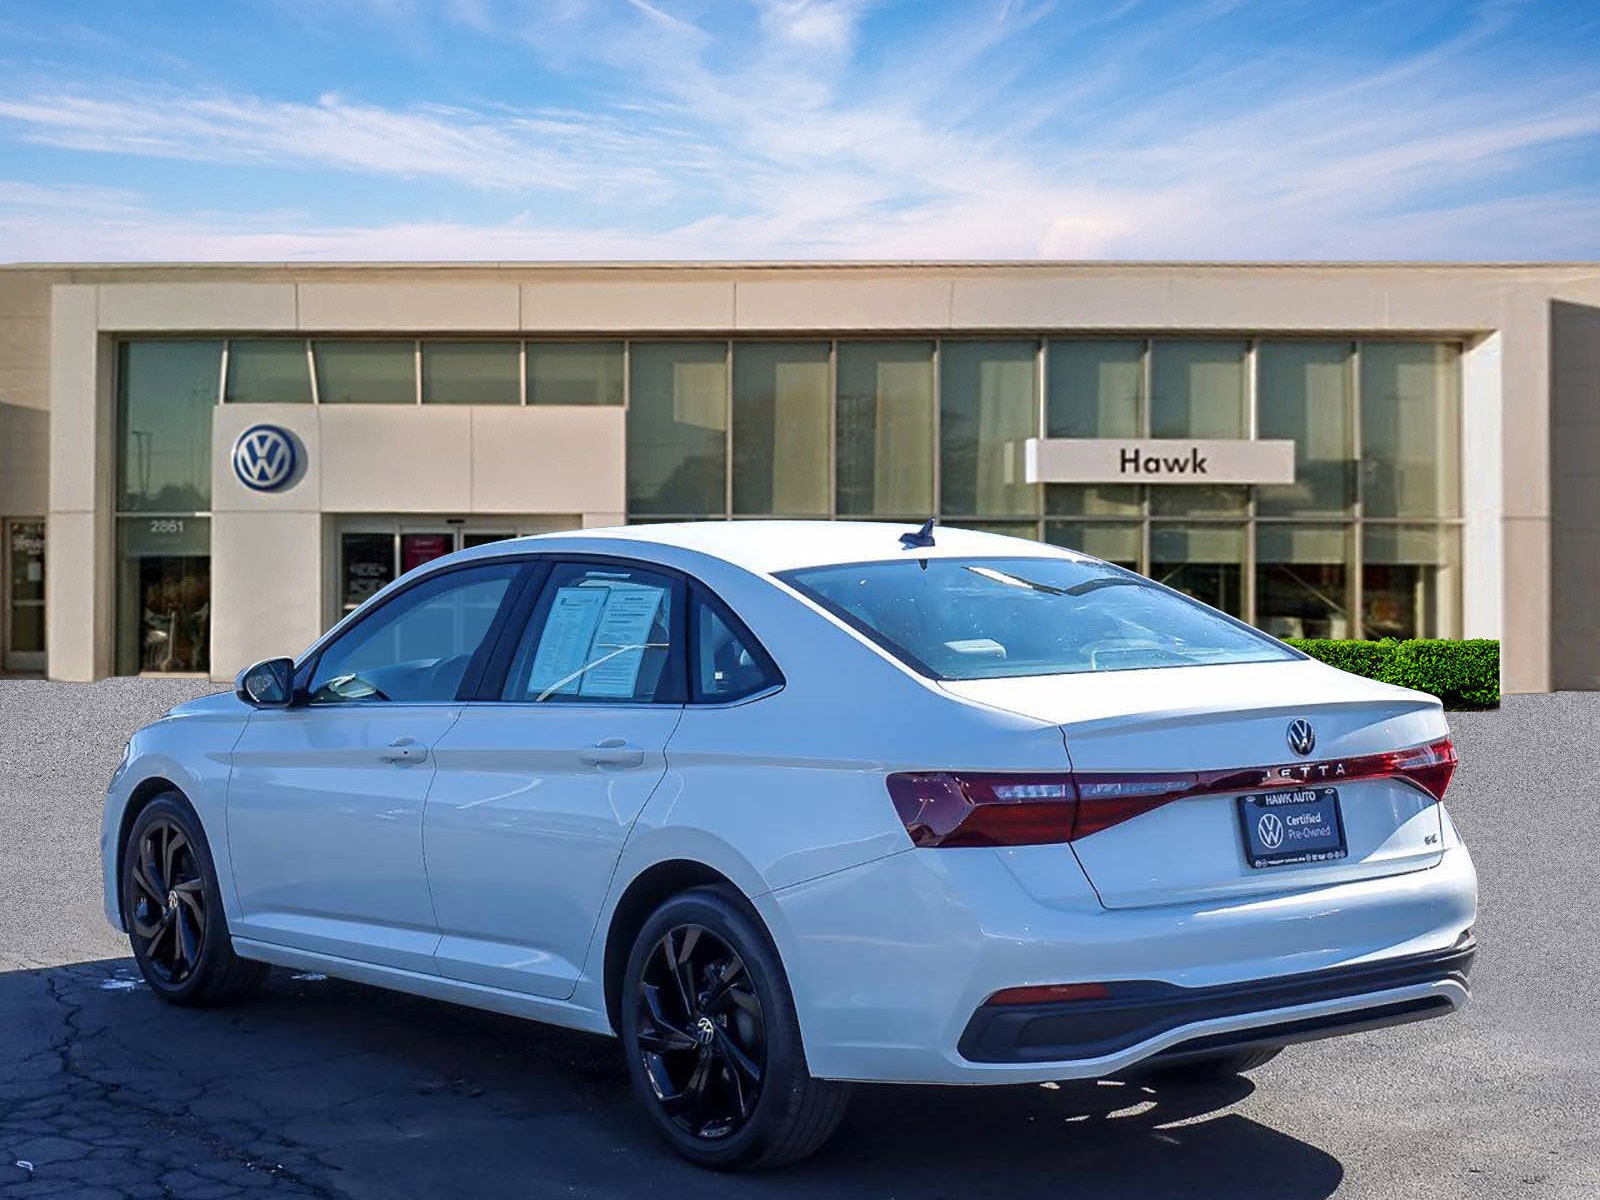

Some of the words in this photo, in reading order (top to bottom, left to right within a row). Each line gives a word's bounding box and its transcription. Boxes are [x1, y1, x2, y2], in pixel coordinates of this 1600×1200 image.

[1119, 448, 1208, 474] Hawk
[1265, 793, 1292, 805] HAWK
[1293, 791, 1316, 802] AUTO
[1286, 812, 1321, 826] Certified
[1288, 825, 1331, 840] Pre-Owned
